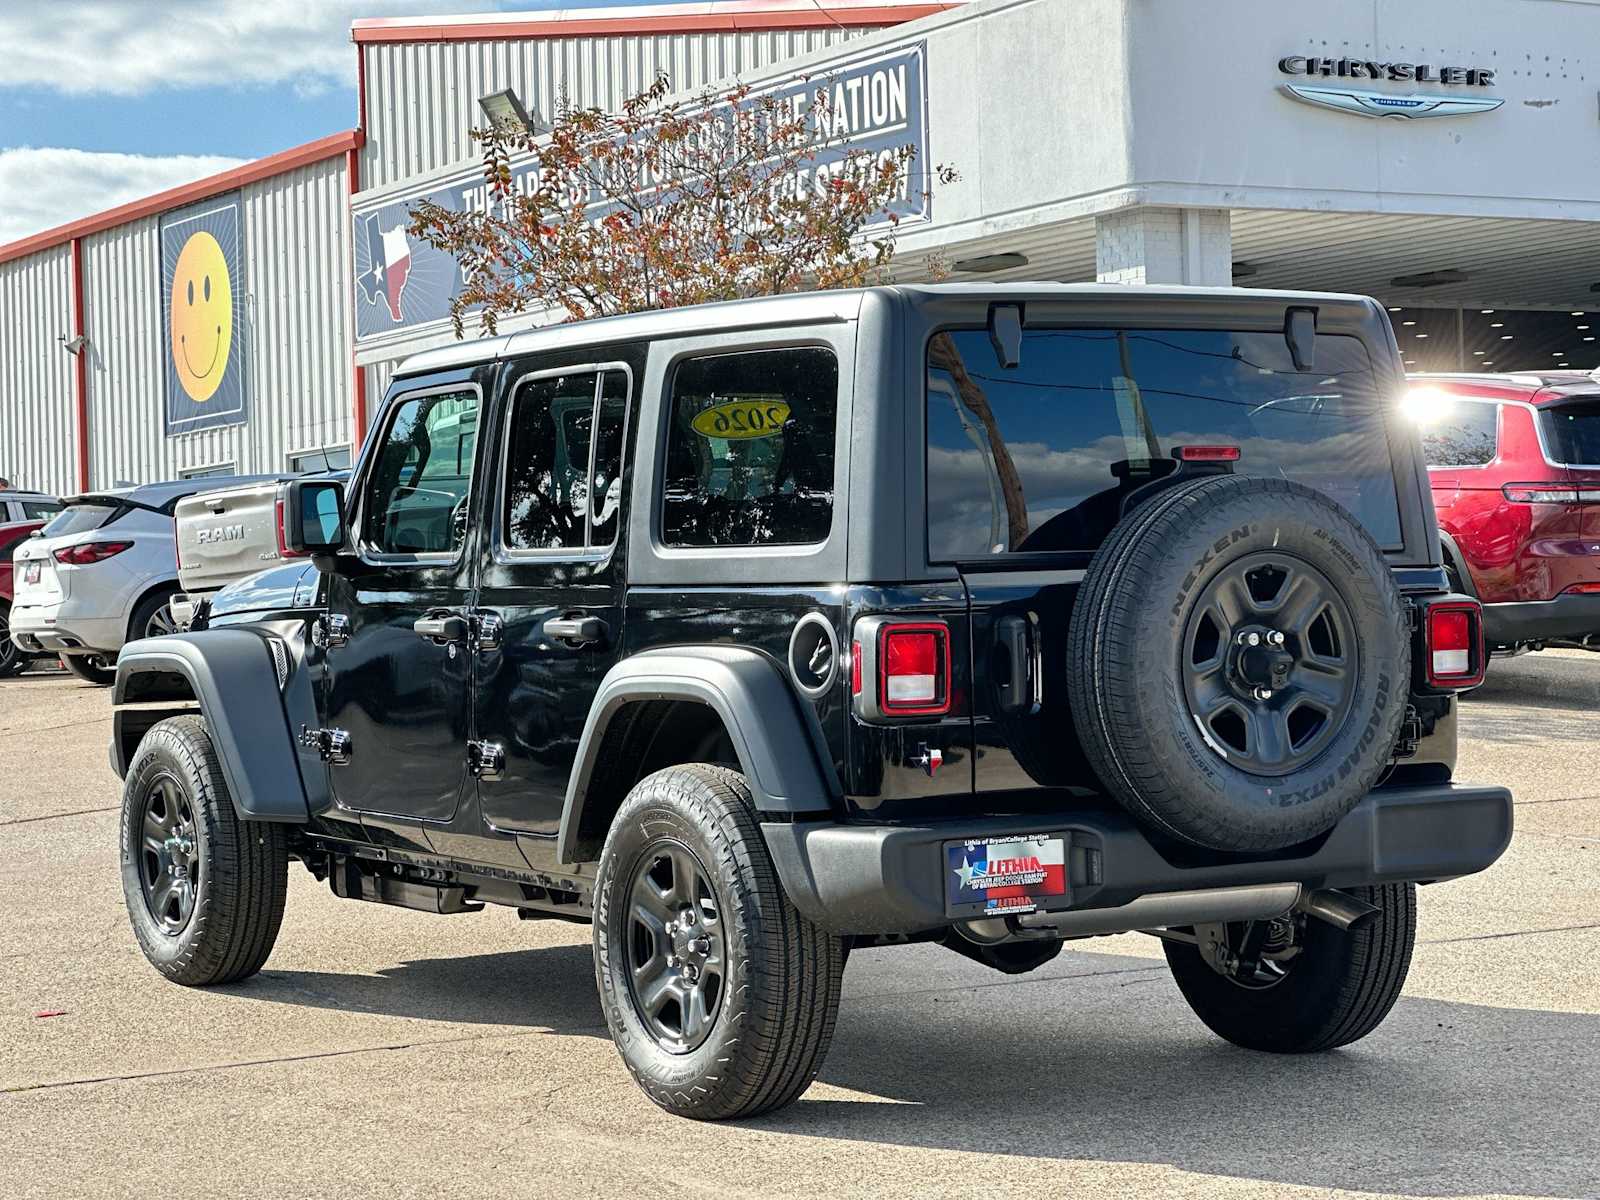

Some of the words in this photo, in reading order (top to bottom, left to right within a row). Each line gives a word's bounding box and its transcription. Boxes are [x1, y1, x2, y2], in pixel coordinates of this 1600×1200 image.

[1278, 55, 1496, 86] CHRYSLER
[814, 64, 907, 142] NATION
[197, 525, 245, 544] RAM
[1172, 525, 1250, 617] NEXEN
[1337, 673, 1391, 780] ROADIAN
[988, 857, 1044, 876] LITHIA
[998, 896, 1033, 908] LITHIA
[599, 930, 627, 1035] ROADIAN
